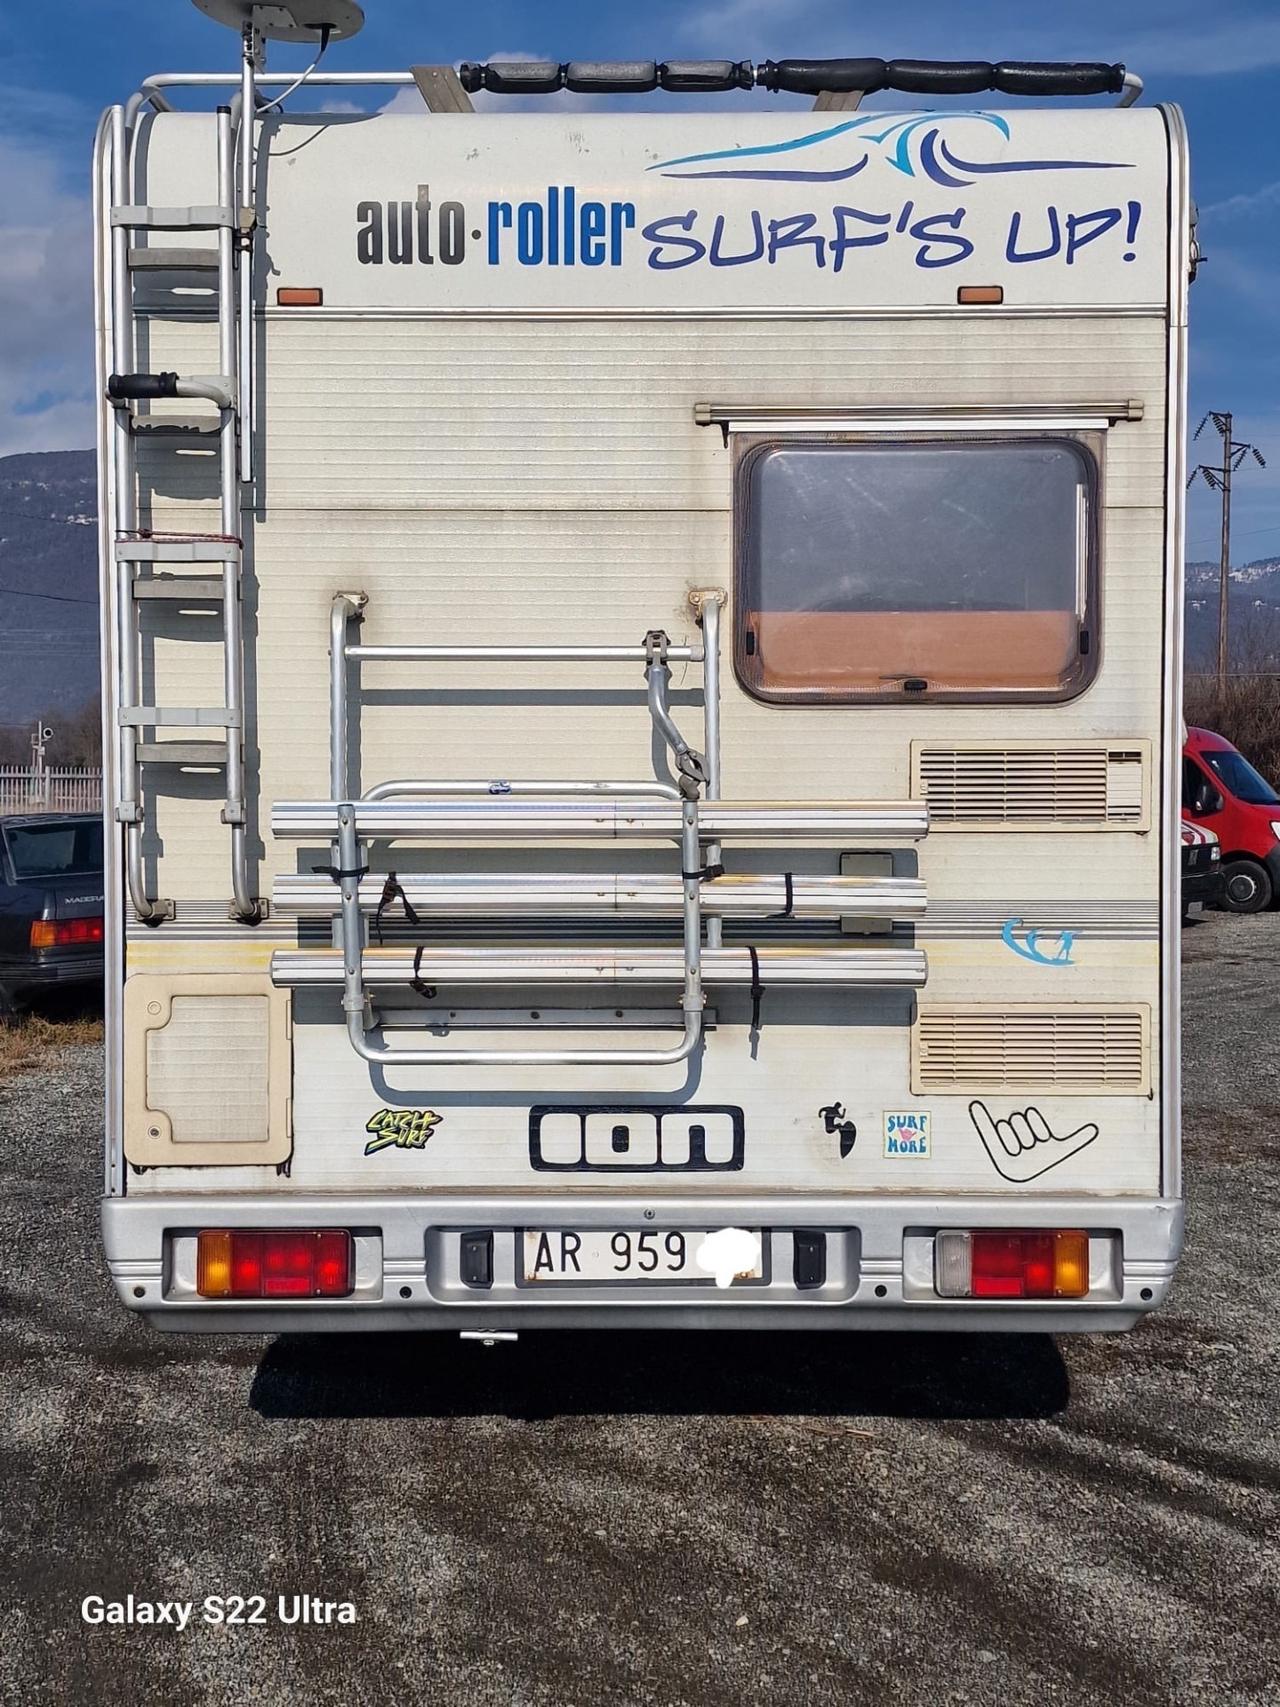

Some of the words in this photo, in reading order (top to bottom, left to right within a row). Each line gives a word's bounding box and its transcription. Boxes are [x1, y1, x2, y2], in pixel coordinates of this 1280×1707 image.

[641, 200, 975, 273] SURF'S
[1004, 200, 1142, 266] UP!
[366, 1109, 444, 1132] CATCH
[887, 1115, 928, 1133] SURF
[365, 1127, 434, 1156] SURF
[887, 1136, 927, 1153] MORE
[534, 1231, 582, 1273] AR
[610, 1231, 687, 1273] 959
